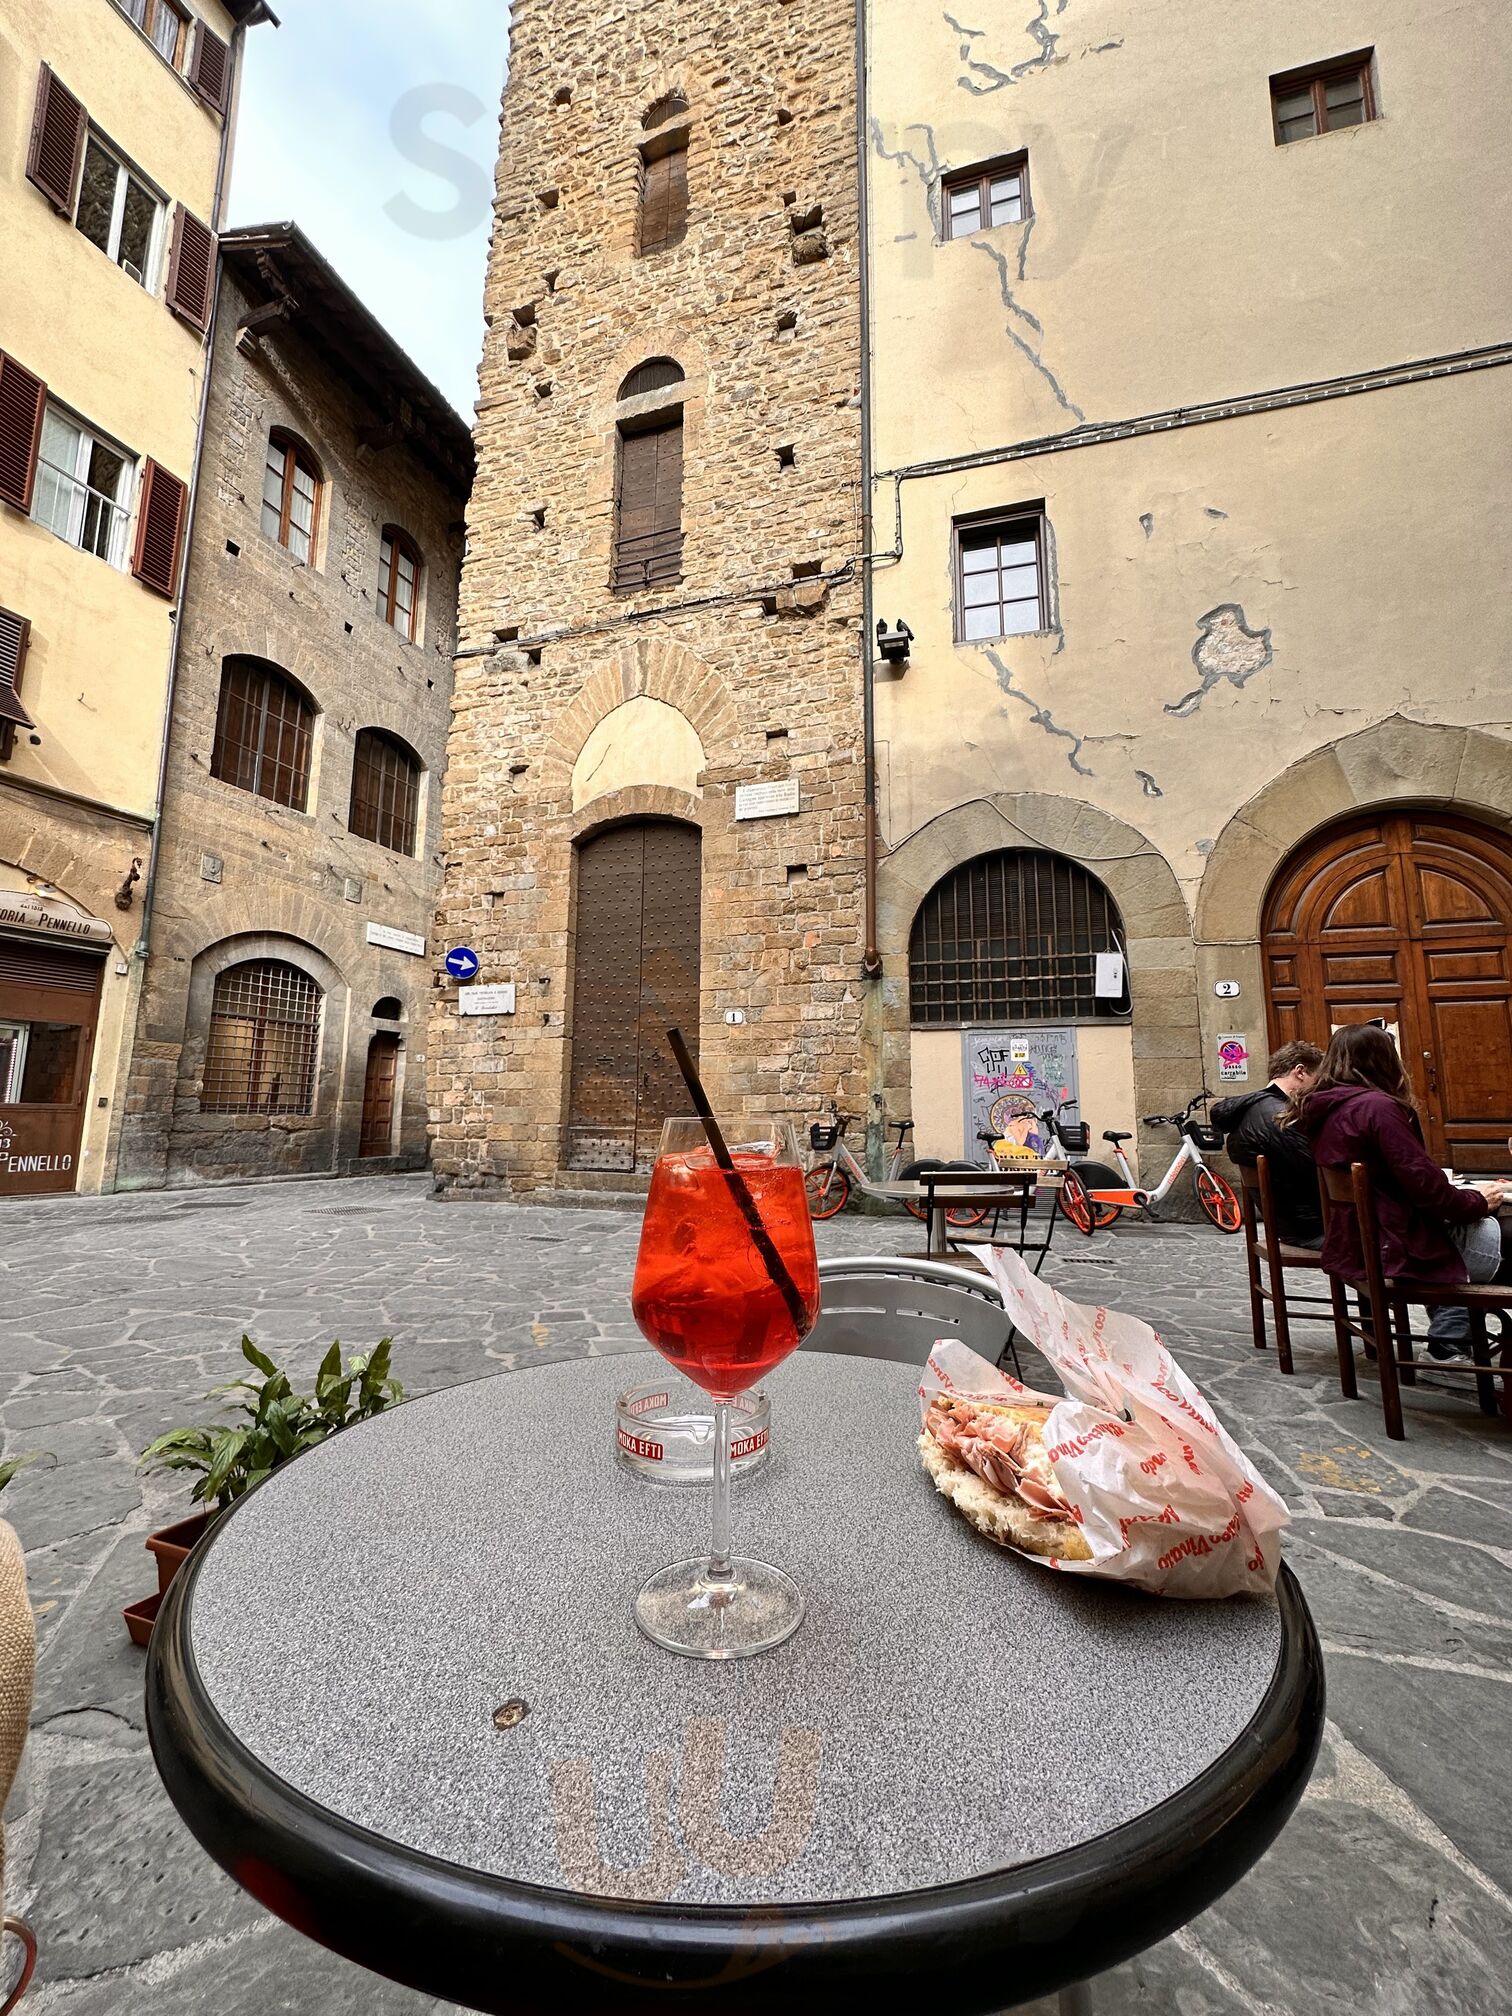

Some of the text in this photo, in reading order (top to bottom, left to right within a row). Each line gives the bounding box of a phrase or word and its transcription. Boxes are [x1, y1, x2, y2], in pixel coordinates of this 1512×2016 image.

[38, 913, 91, 935] PENNELLO
[1222, 984, 1232, 995] 2
[618, 1430, 661, 1459] MOKA EFTI
[731, 1437, 755, 1456] MOKA
[1158, 1535, 1213, 1569] Vinaio
